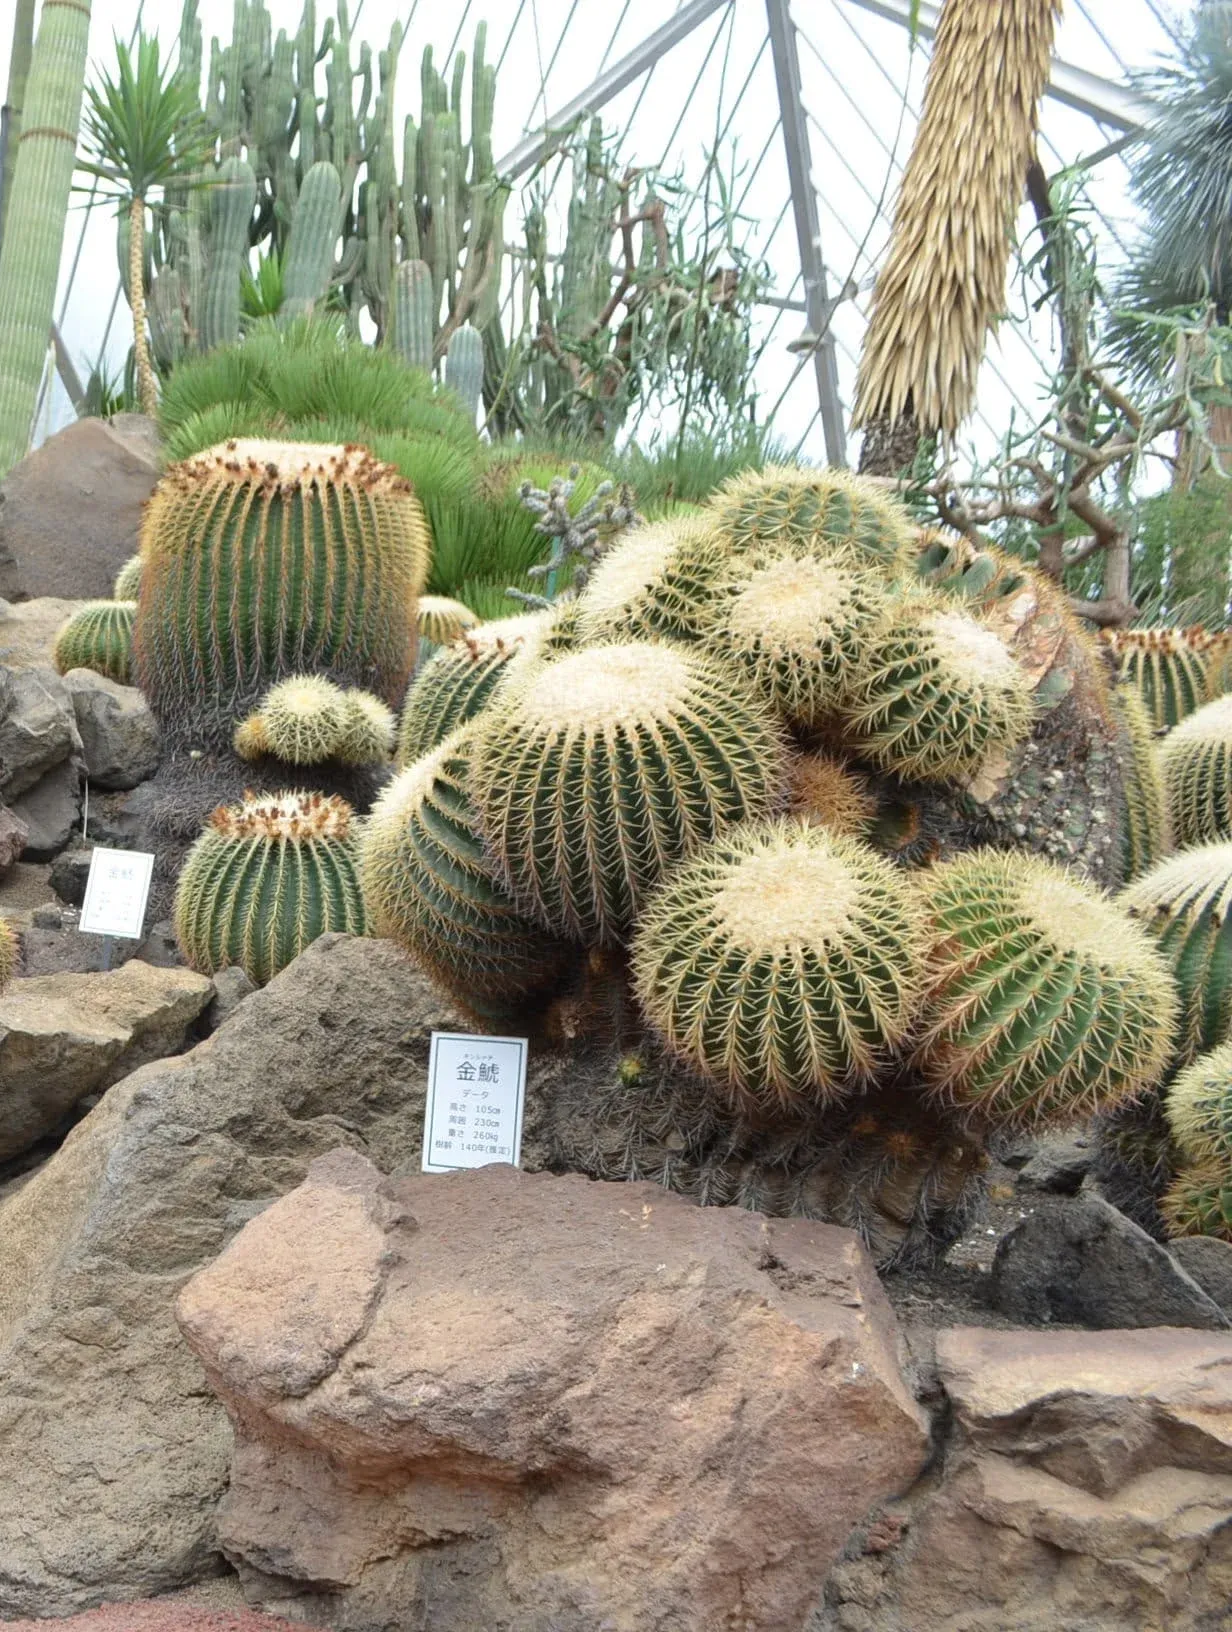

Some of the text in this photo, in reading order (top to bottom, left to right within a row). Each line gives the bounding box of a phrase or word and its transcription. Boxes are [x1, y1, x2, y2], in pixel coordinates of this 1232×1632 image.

[456, 1061, 501, 1084] 金鯱
[462, 1089, 489, 1100] データ
